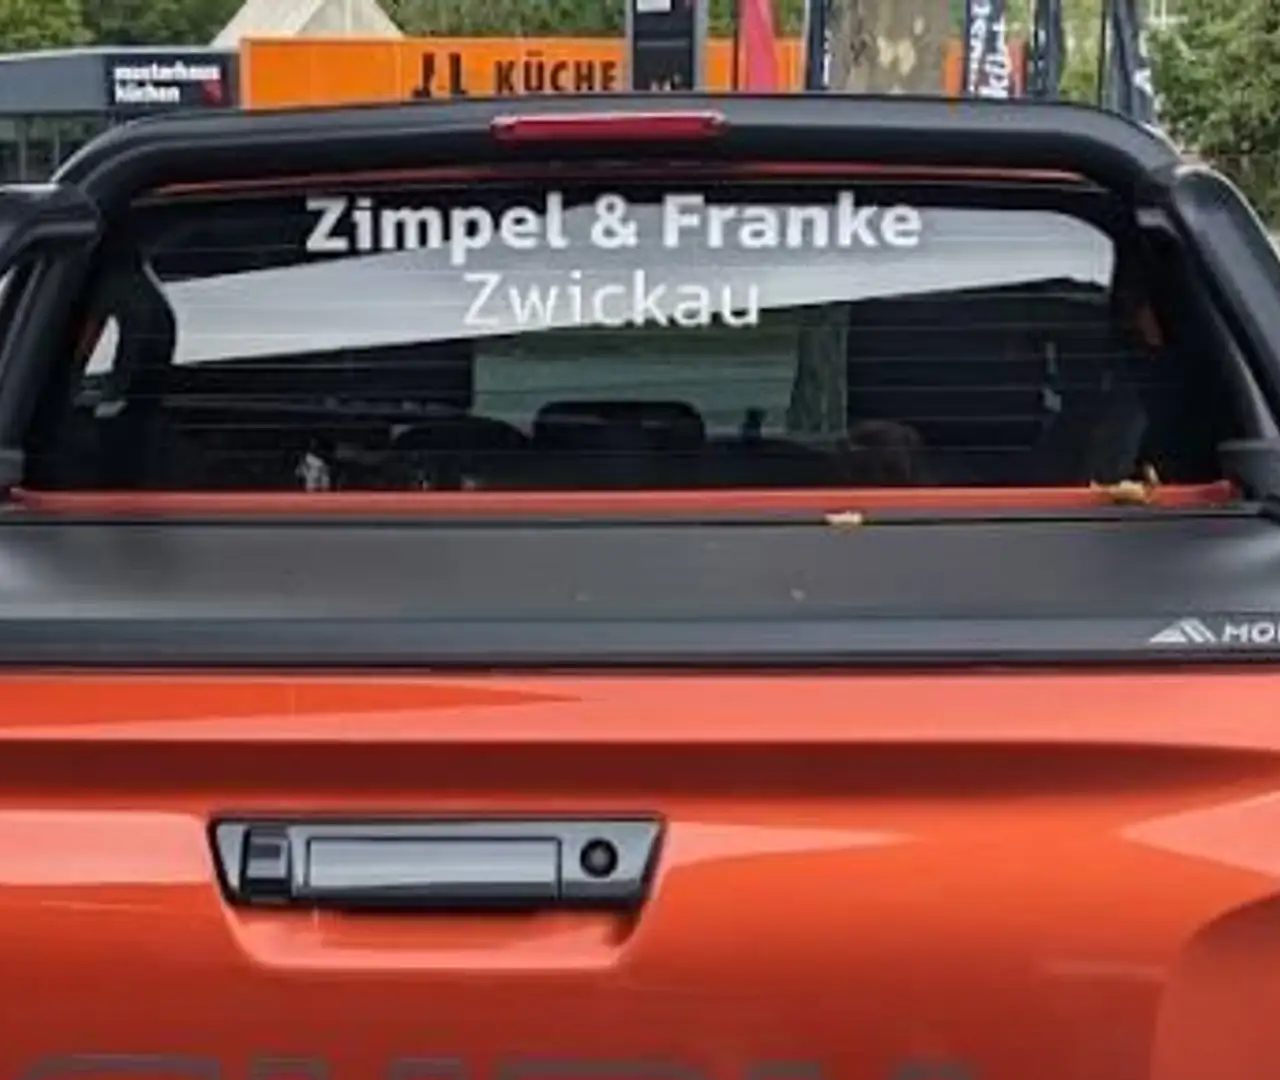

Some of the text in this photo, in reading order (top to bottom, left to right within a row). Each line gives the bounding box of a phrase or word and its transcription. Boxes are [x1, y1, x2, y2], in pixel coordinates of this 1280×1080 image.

[305, 192, 923, 265] Zimpel & Franke
[462, 270, 761, 328] Zwickau
